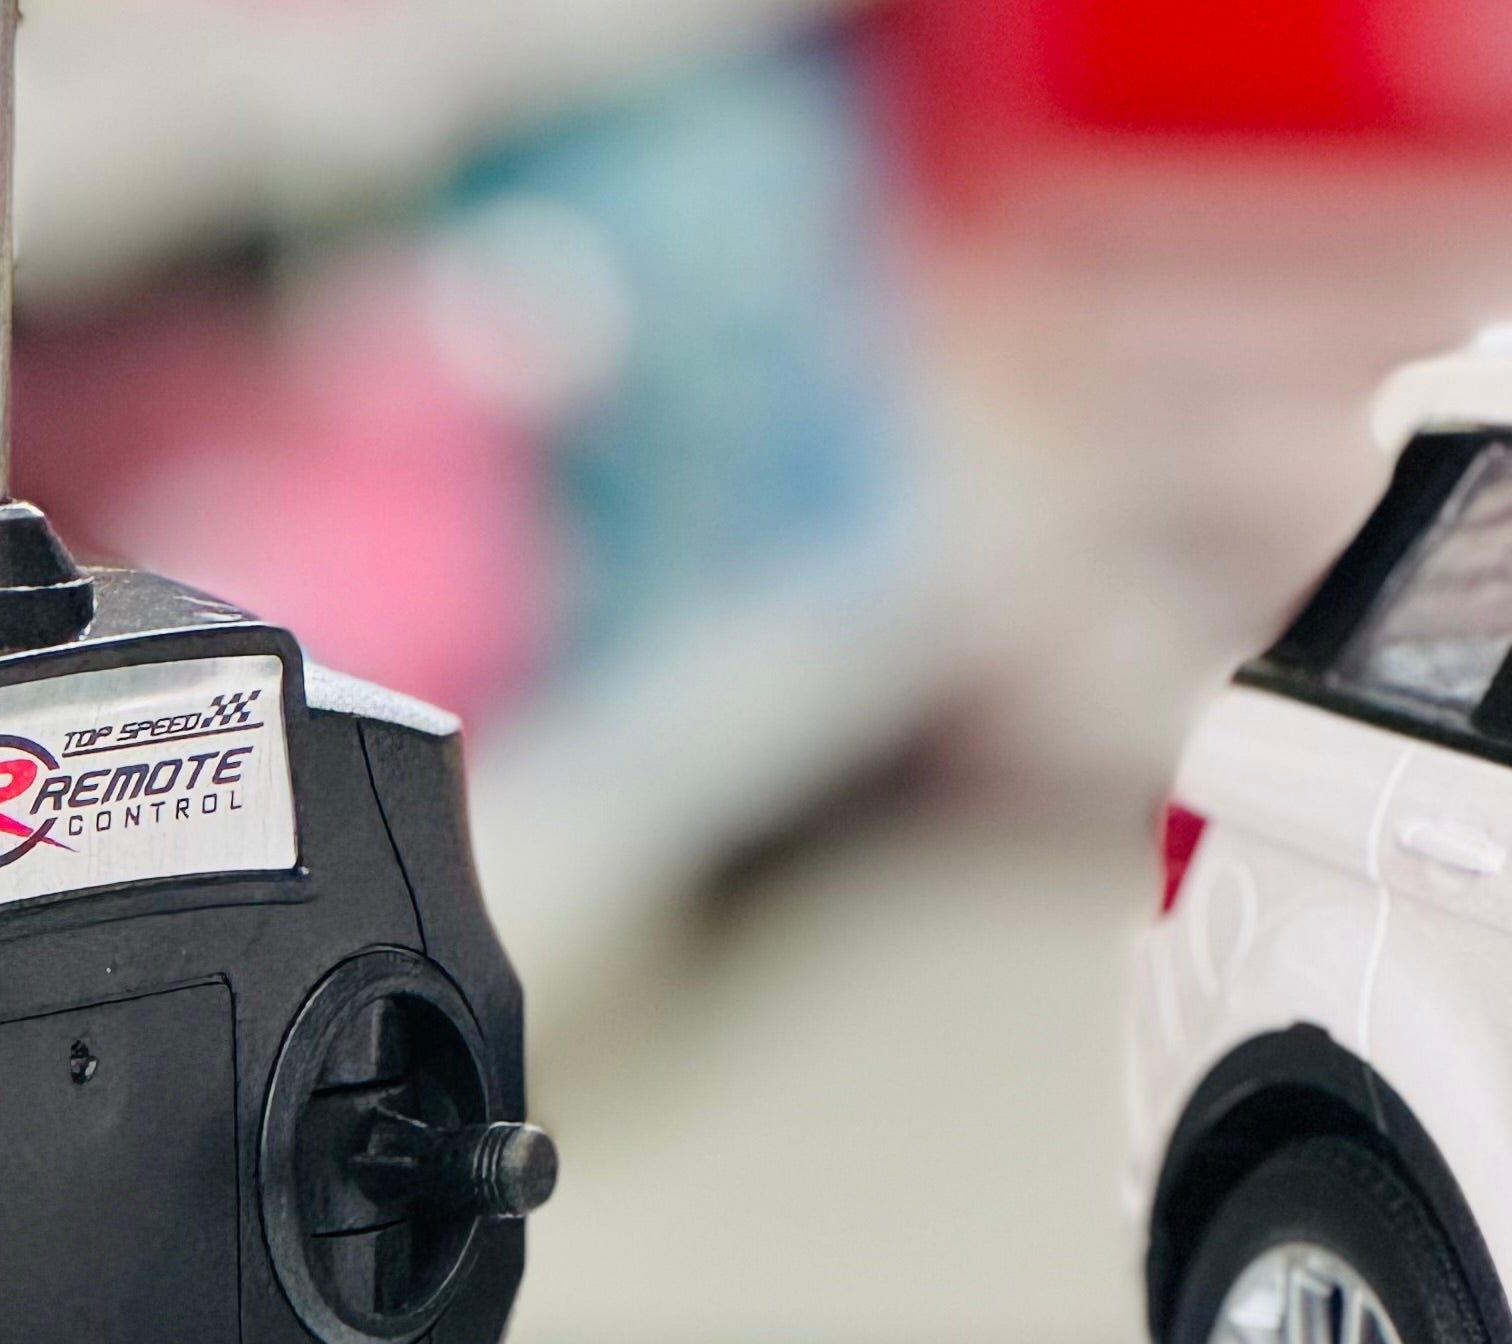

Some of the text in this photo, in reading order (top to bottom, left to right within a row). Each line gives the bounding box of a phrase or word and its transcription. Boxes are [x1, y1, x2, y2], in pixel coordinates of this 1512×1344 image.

[64, 712, 202, 751] TOP SPEED
[29, 746, 254, 815] REMOTE
[68, 790, 243, 836] CONTROL
